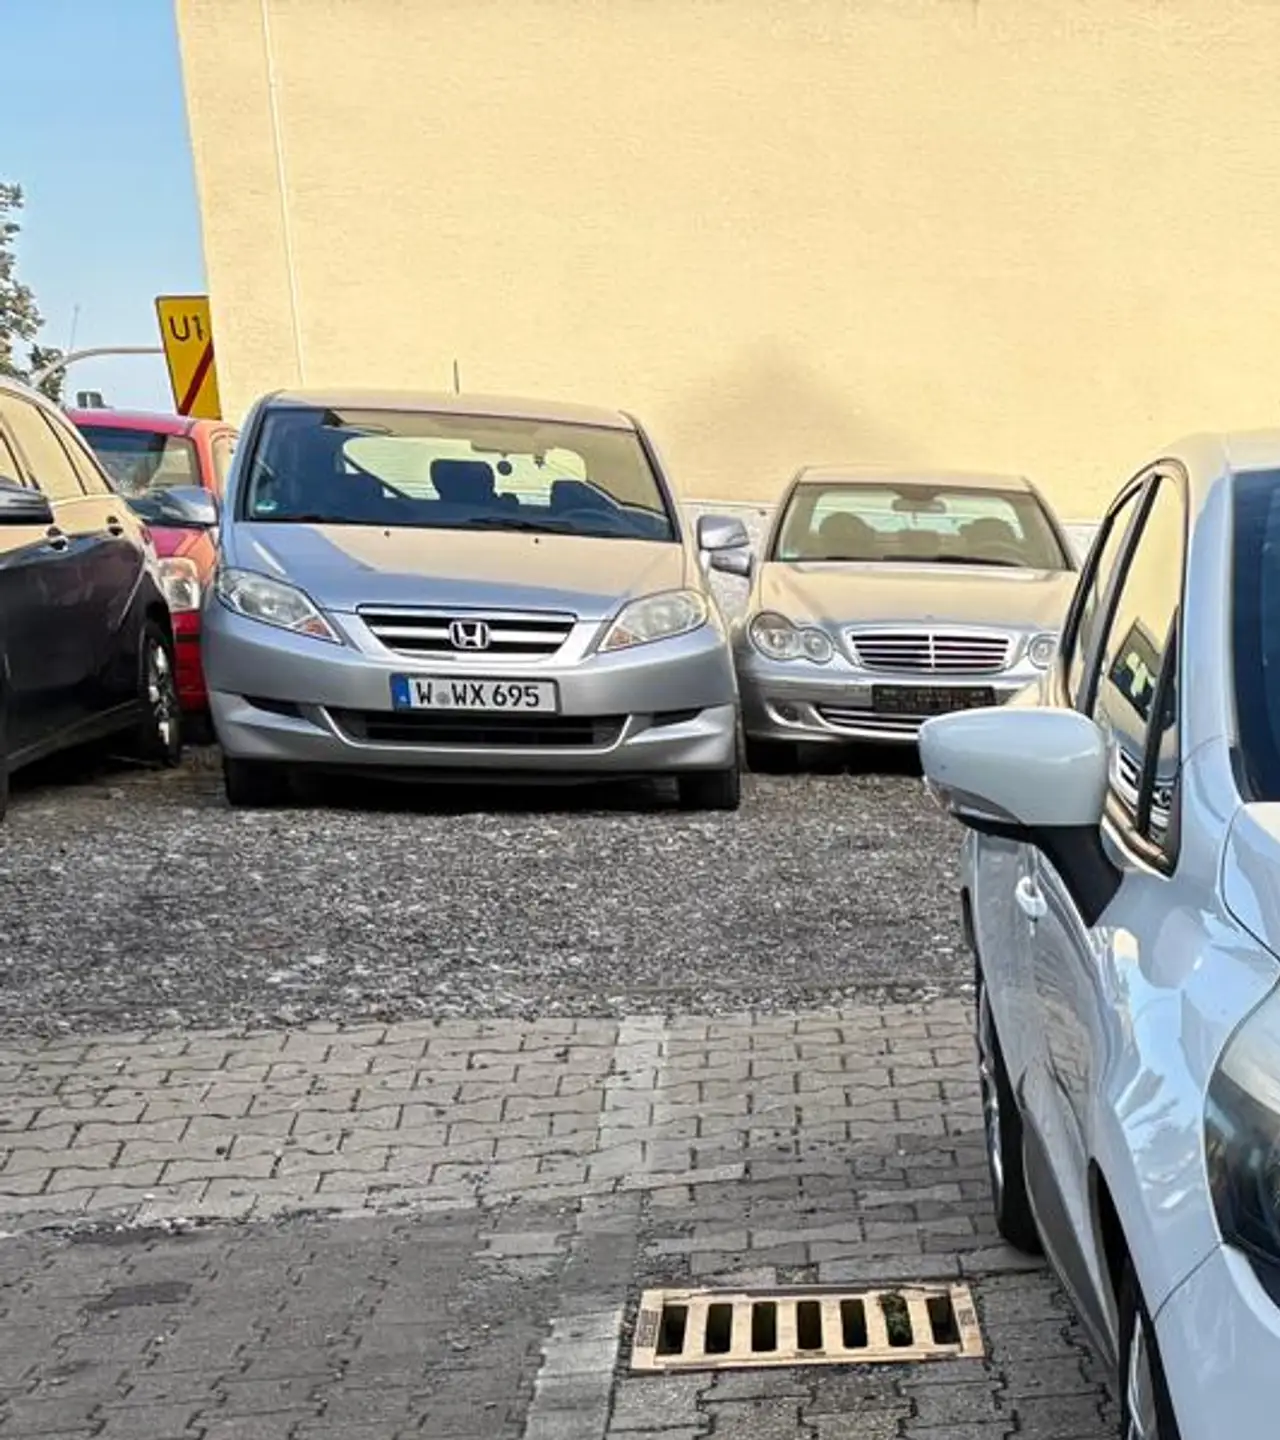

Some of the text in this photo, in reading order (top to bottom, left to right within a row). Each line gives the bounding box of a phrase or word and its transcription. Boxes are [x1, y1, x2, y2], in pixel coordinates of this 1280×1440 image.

[416, 682, 540, 707] W WX 695
